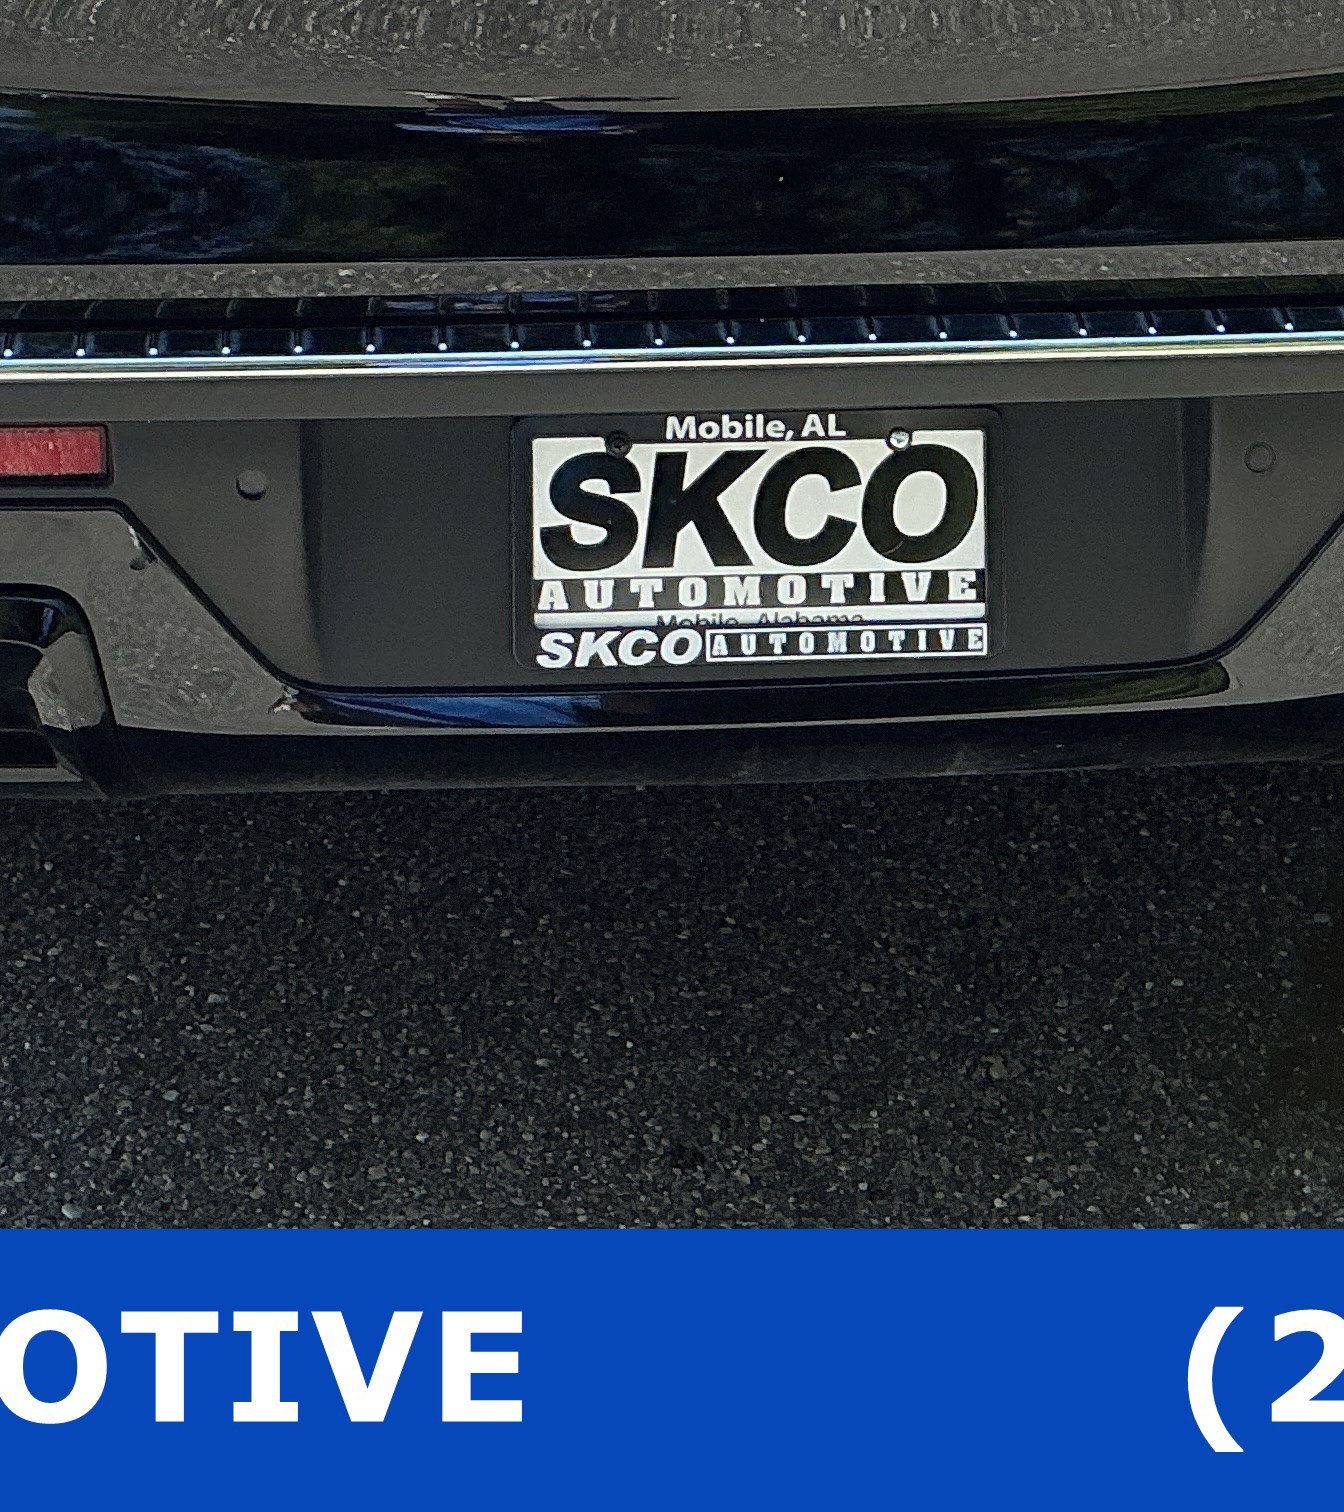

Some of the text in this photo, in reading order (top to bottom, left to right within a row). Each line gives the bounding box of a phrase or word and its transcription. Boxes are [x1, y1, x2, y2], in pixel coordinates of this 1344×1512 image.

[664, 412, 848, 442] Mobile, AL
[538, 443, 980, 572] SKCO
[537, 570, 979, 611] AUTOMOTIVE
[536, 628, 704, 669] SKCO
[711, 629, 984, 657] AUTOMOTIVE
